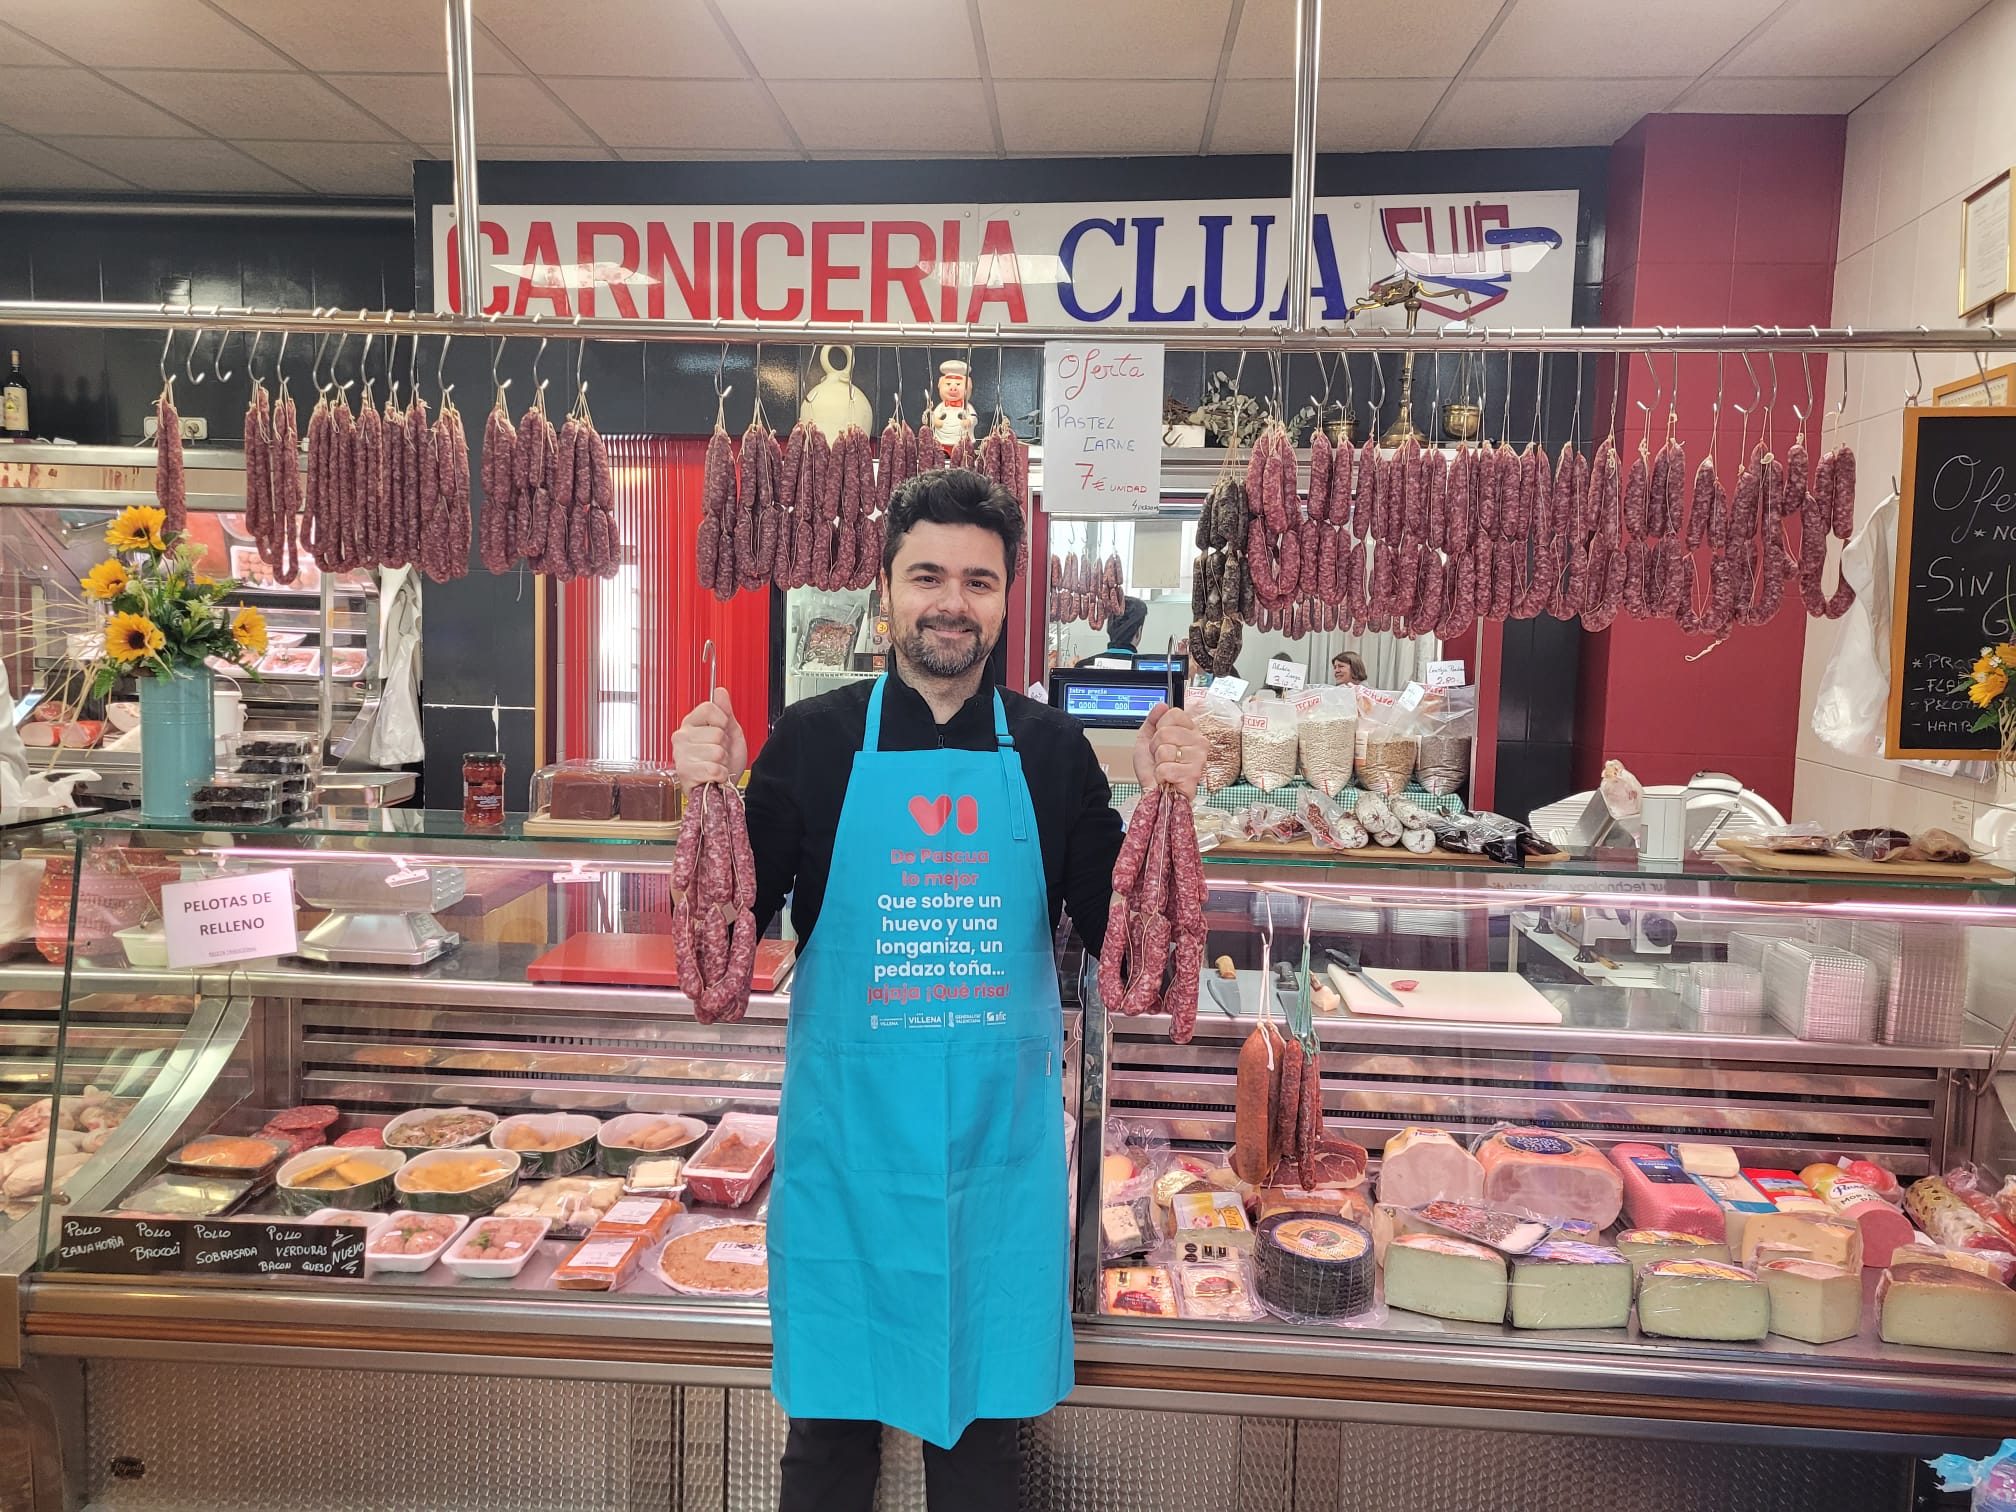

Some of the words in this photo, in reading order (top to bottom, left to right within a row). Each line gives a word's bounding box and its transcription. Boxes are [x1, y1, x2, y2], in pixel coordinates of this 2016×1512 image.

[448, 219, 1028, 323] CARNICERIA
[1057, 215, 1354, 323] CLUA
[1058, 348, 1145, 400] Oferta
[1051, 404, 1116, 430] PASTEL
[1083, 436, 1136, 452] CARNE
[1109, 484, 1148, 493] UNIDAD
[1933, 454, 2016, 544] Ofe
[890, 849, 916, 865] De
[920, 848, 990, 864] Pascua
[902, 870, 920, 887] lo
[924, 869, 979, 891] mejor
[184, 894, 248, 913] PELOTAS
[252, 892, 273, 905] DE
[877, 894, 917, 911] Que
[921, 893, 973, 908] sobre
[978, 896, 1002, 908] un
[200, 917, 265, 936] RELLENO
[882, 916, 943, 932] huevo
[946, 918, 959, 936] y
[962, 918, 998, 931] una
[876, 937, 976, 959] longaniza,
[980, 940, 1003, 953] un
[874, 961, 945, 982] pedazo
[949, 960, 1005, 977] toña...
[867, 983, 921, 1005] jajaja
[926, 982, 970, 1002] ¡Qué
[974, 982, 1010, 998] risa!
[908, 1015, 942, 1024] VILLENA
[195, 1246, 258, 1265] SOBRASADA
[276, 1246, 328, 1257] VERDURAS
[331, 1242, 365, 1266] NUEVO
[258, 1261, 292, 1273] BACON
